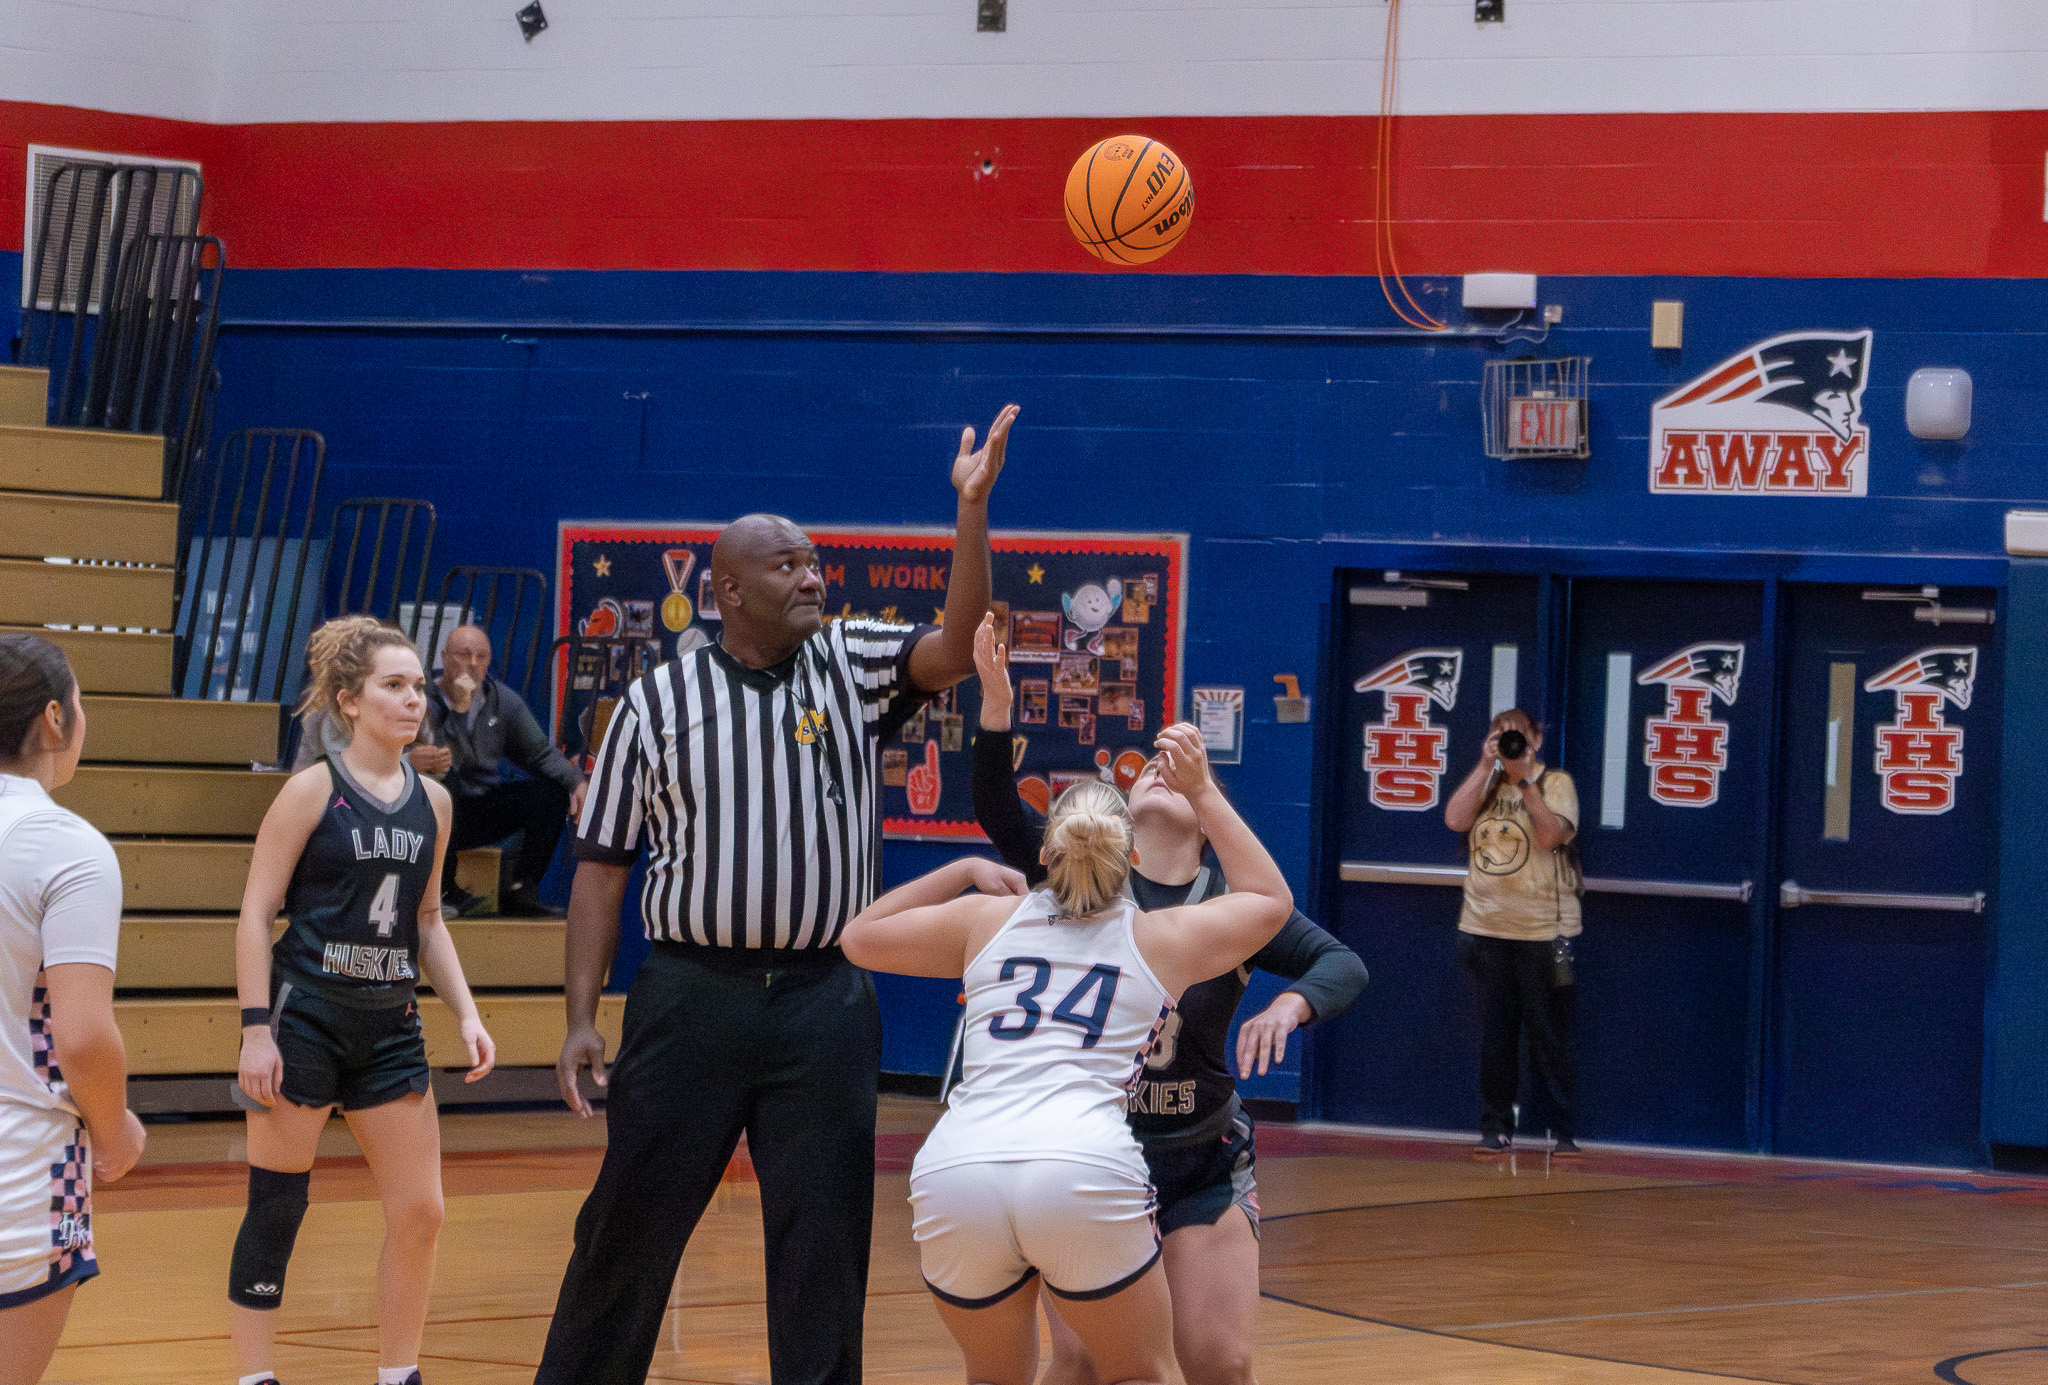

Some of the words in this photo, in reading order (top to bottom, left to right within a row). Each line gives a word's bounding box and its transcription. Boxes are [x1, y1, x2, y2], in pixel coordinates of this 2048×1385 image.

[1146, 152, 1176, 196] EVO
[1521, 403, 1567, 446] EXIT
[1655, 428, 1866, 493] AWAY
[867, 564, 946, 590] WORK
[351, 827, 424, 864] LADY
[367, 872, 401, 937] 4
[988, 956, 1122, 1050] 34
[1128, 1080, 1196, 1115] KIES
